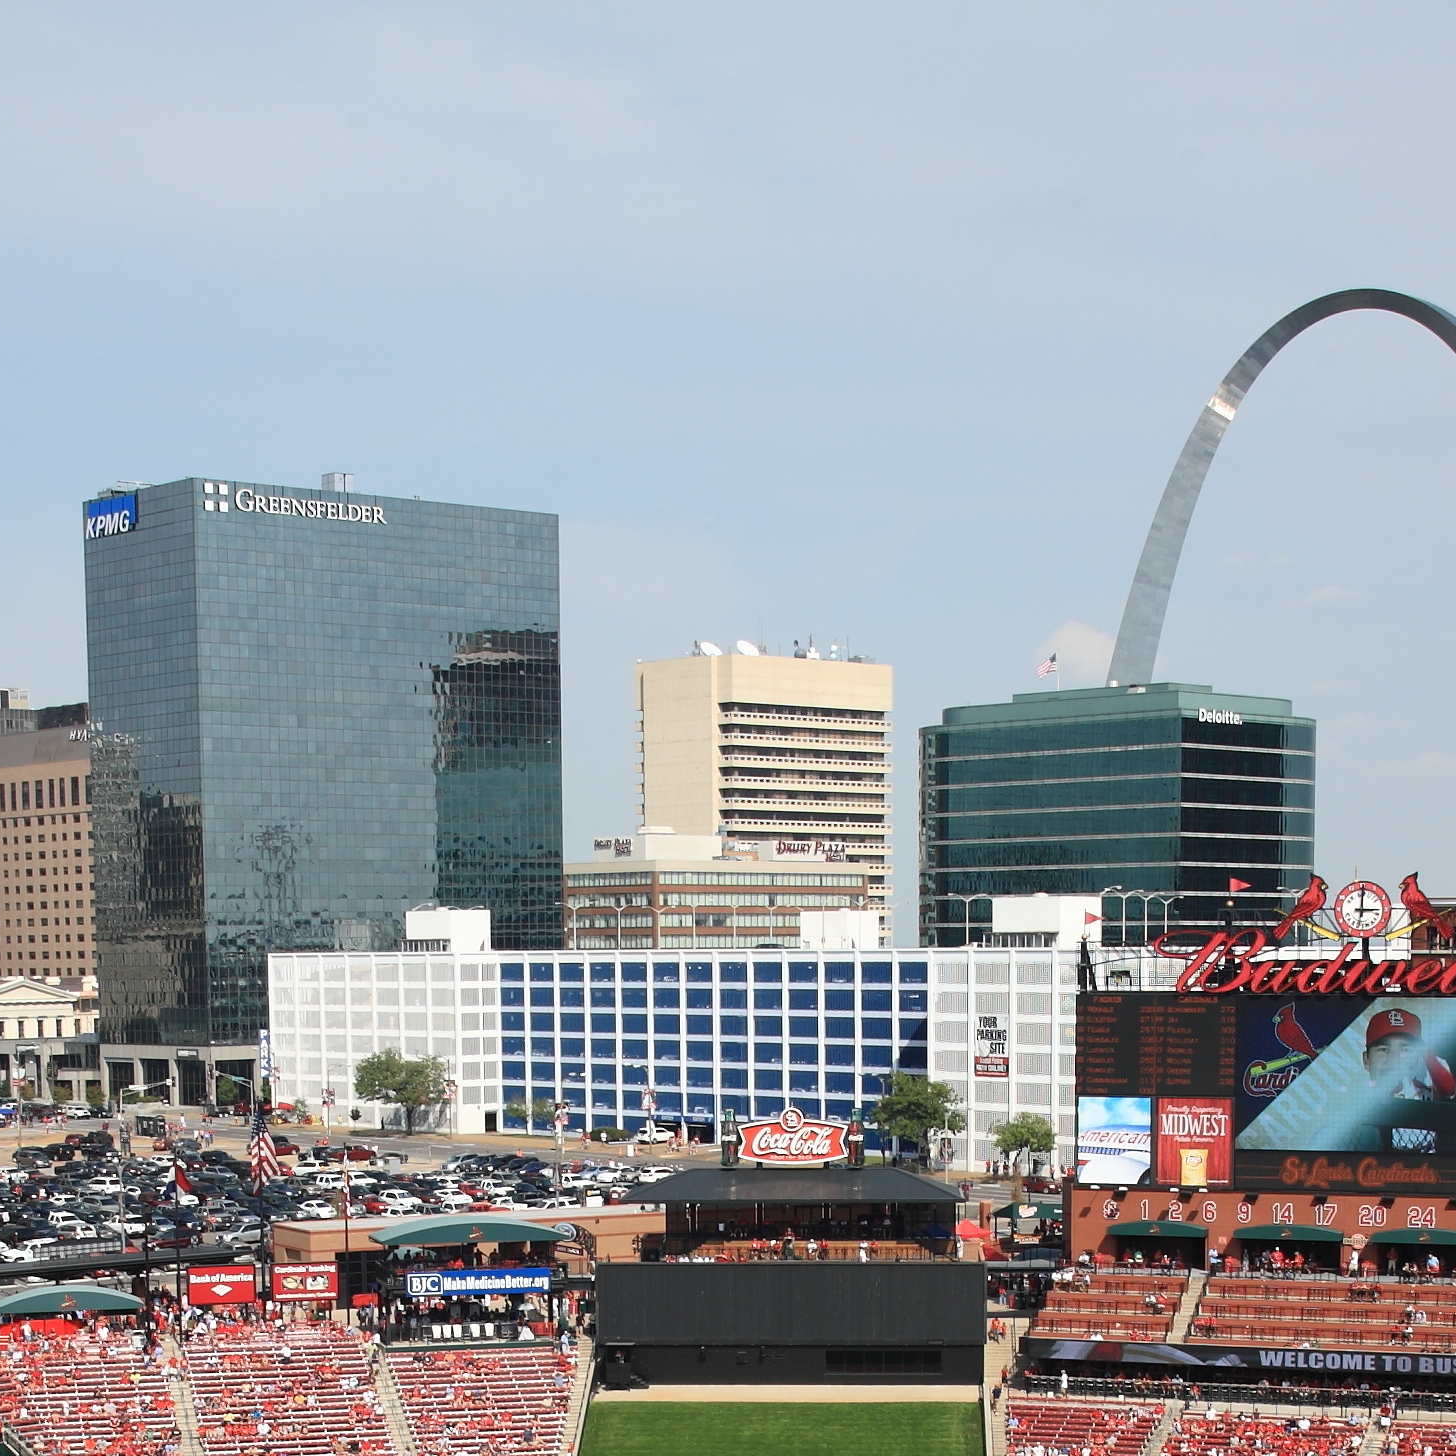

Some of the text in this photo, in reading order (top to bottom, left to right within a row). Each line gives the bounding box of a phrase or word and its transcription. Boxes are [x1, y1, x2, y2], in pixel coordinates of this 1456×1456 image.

[235, 488, 387, 525] GREENSFELDER
[85, 510, 131, 540] KPMG
[776, 838, 847, 856] DRURY PLAZA
[978, 1016, 997, 1028] YOUR
[976, 1029, 1007, 1041] PARKING
[990, 1042, 1005, 1054] SITE
[1160, 1114, 1229, 1137] MIDWEST
[752, 1126, 834, 1156] Coca-Cola
[1357, 1156, 1438, 1187] Cardinals
[1140, 1199, 1149, 1221] 1
[1168, 1200, 1183, 1222] 2
[1202, 1201, 1217, 1222] 6
[1237, 1202, 1252, 1223] 9
[1272, 1203, 1293, 1225] 14
[1315, 1203, 1338, 1226] 17
[1358, 1205, 1387, 1227] 20
[1407, 1206, 1436, 1229] 24
[189, 1274, 211, 1283] Bank
[220, 1273, 254, 1282] America
[411, 1274, 550, 1293] BJC MakeMedicineBetter.org
[1259, 1349, 1377, 1372] WELCOME
[1381, 1353, 1411, 1372] TO
